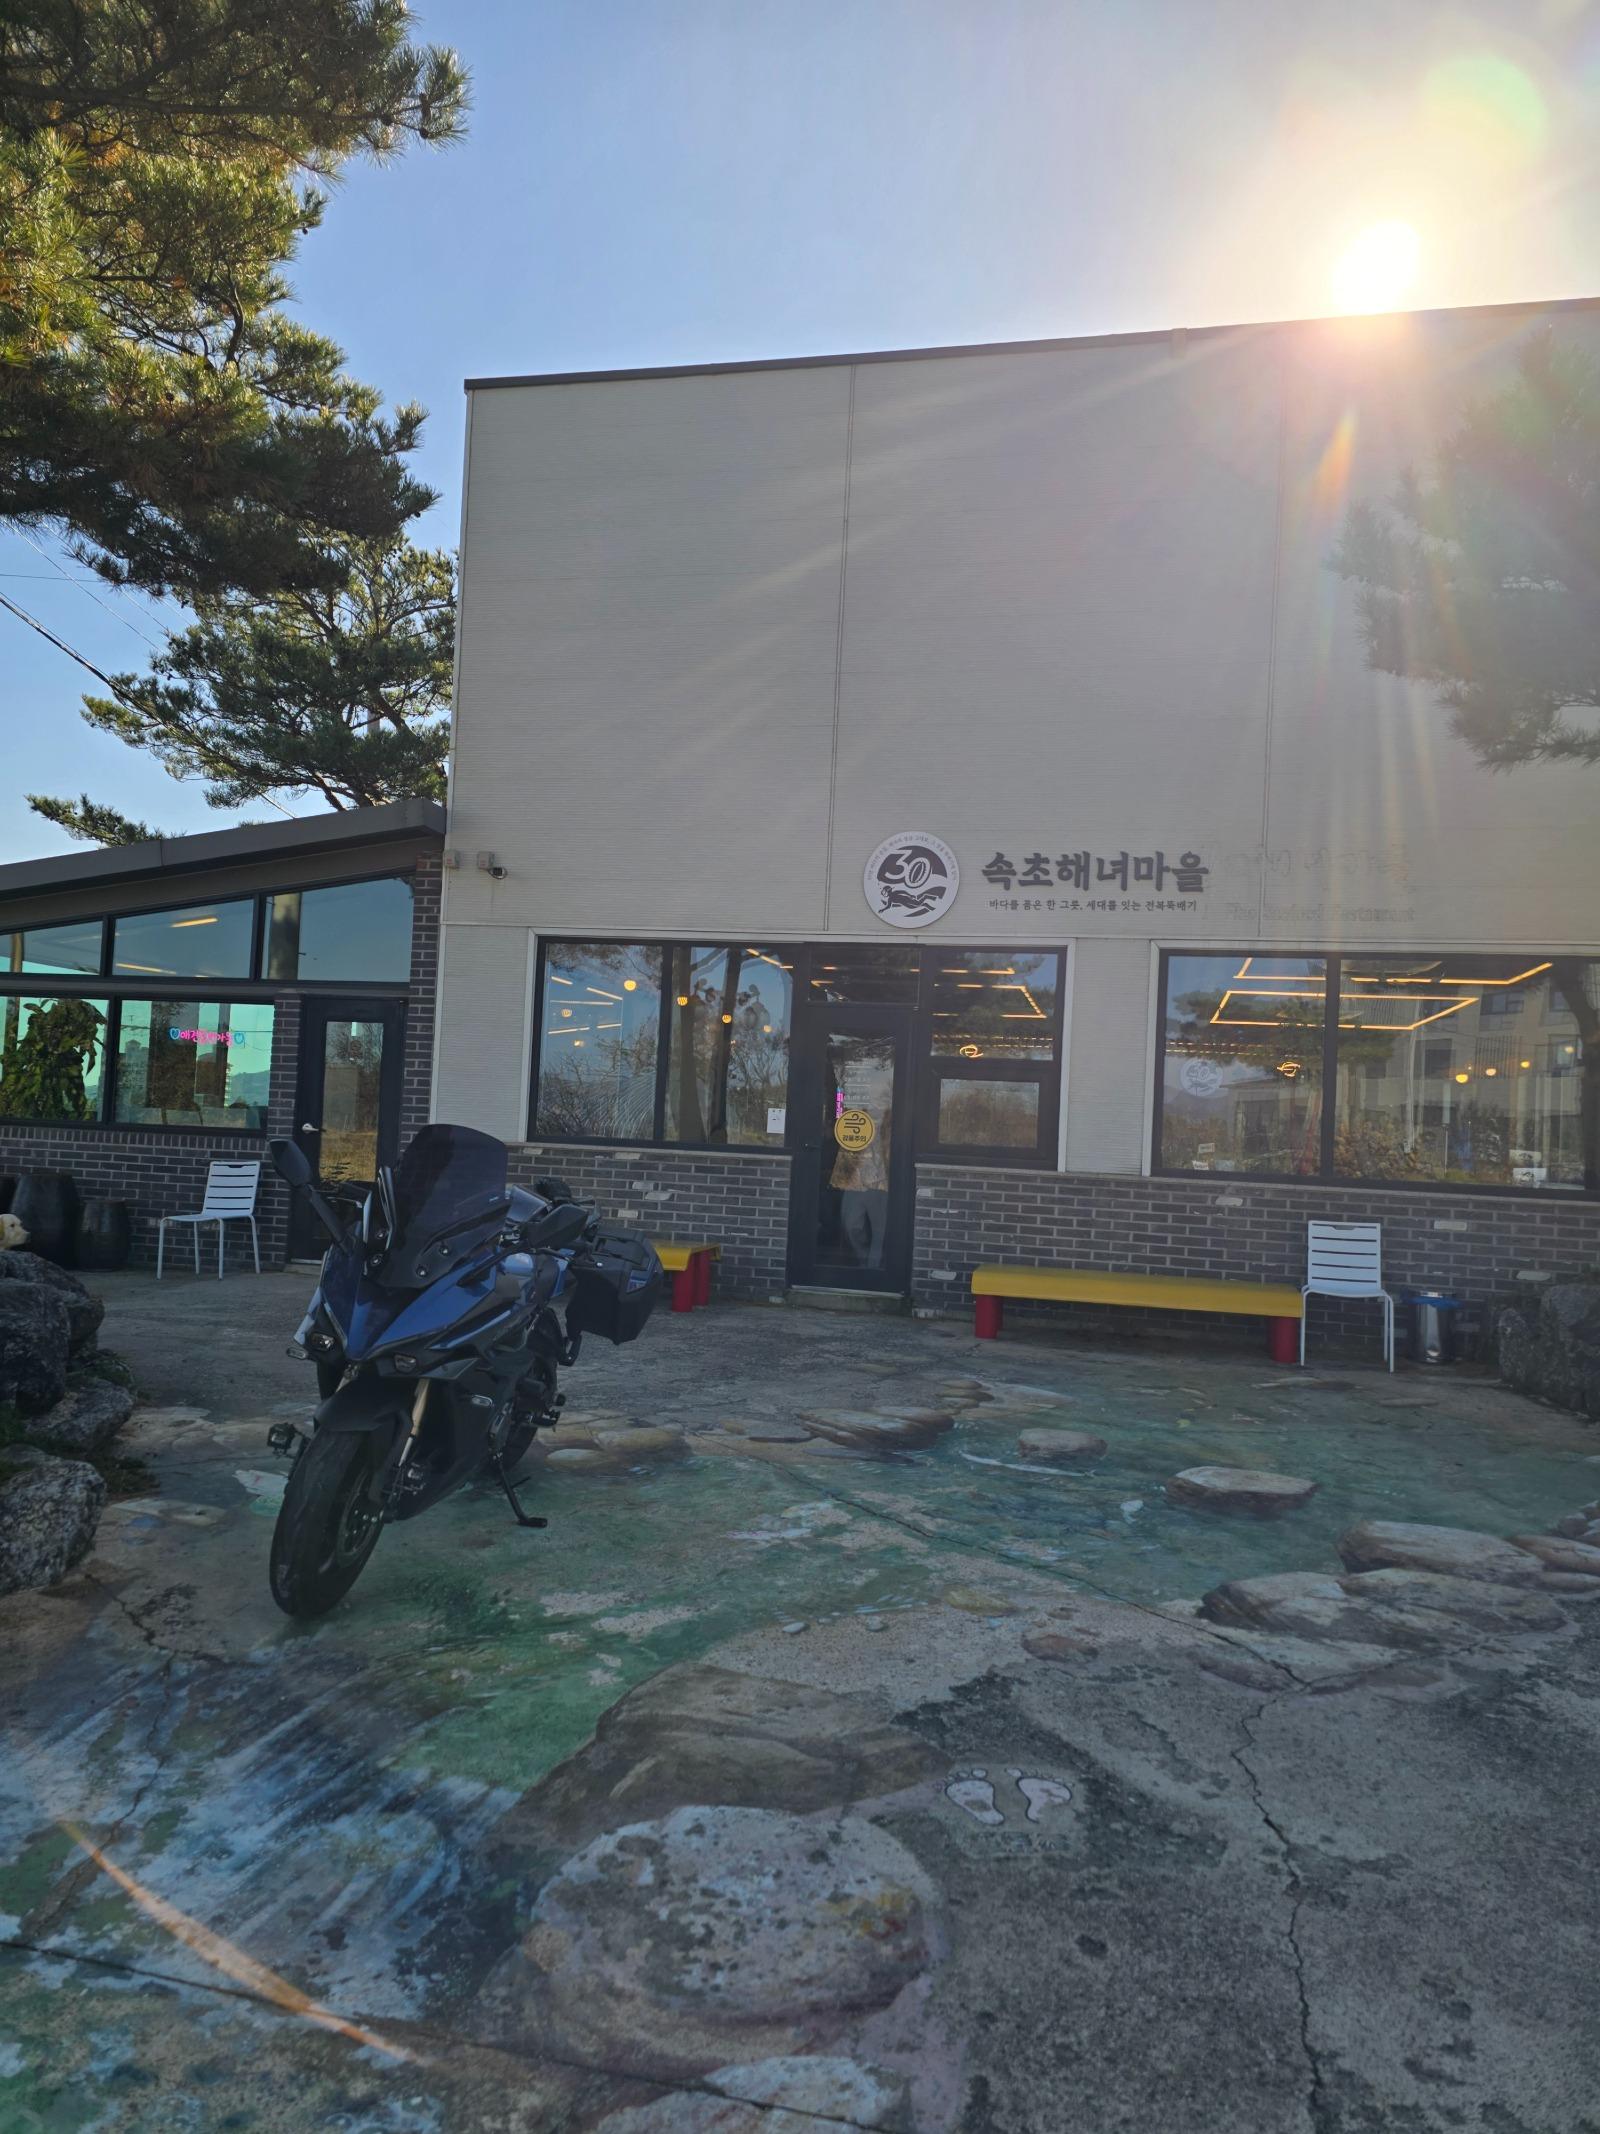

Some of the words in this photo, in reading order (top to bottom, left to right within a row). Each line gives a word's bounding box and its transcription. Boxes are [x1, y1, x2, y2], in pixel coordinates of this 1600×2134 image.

[981, 850, 1210, 892] 속초해녀마을
[989, 899, 1019, 911] 바다를
[1022, 899, 1043, 911] 품은
[1046, 899, 1056, 911] 한
[1086, 899, 1117, 911] 세대를
[1121, 899, 1141, 911] 잇는
[1144, 899, 1198, 912] 전복뚝배기
